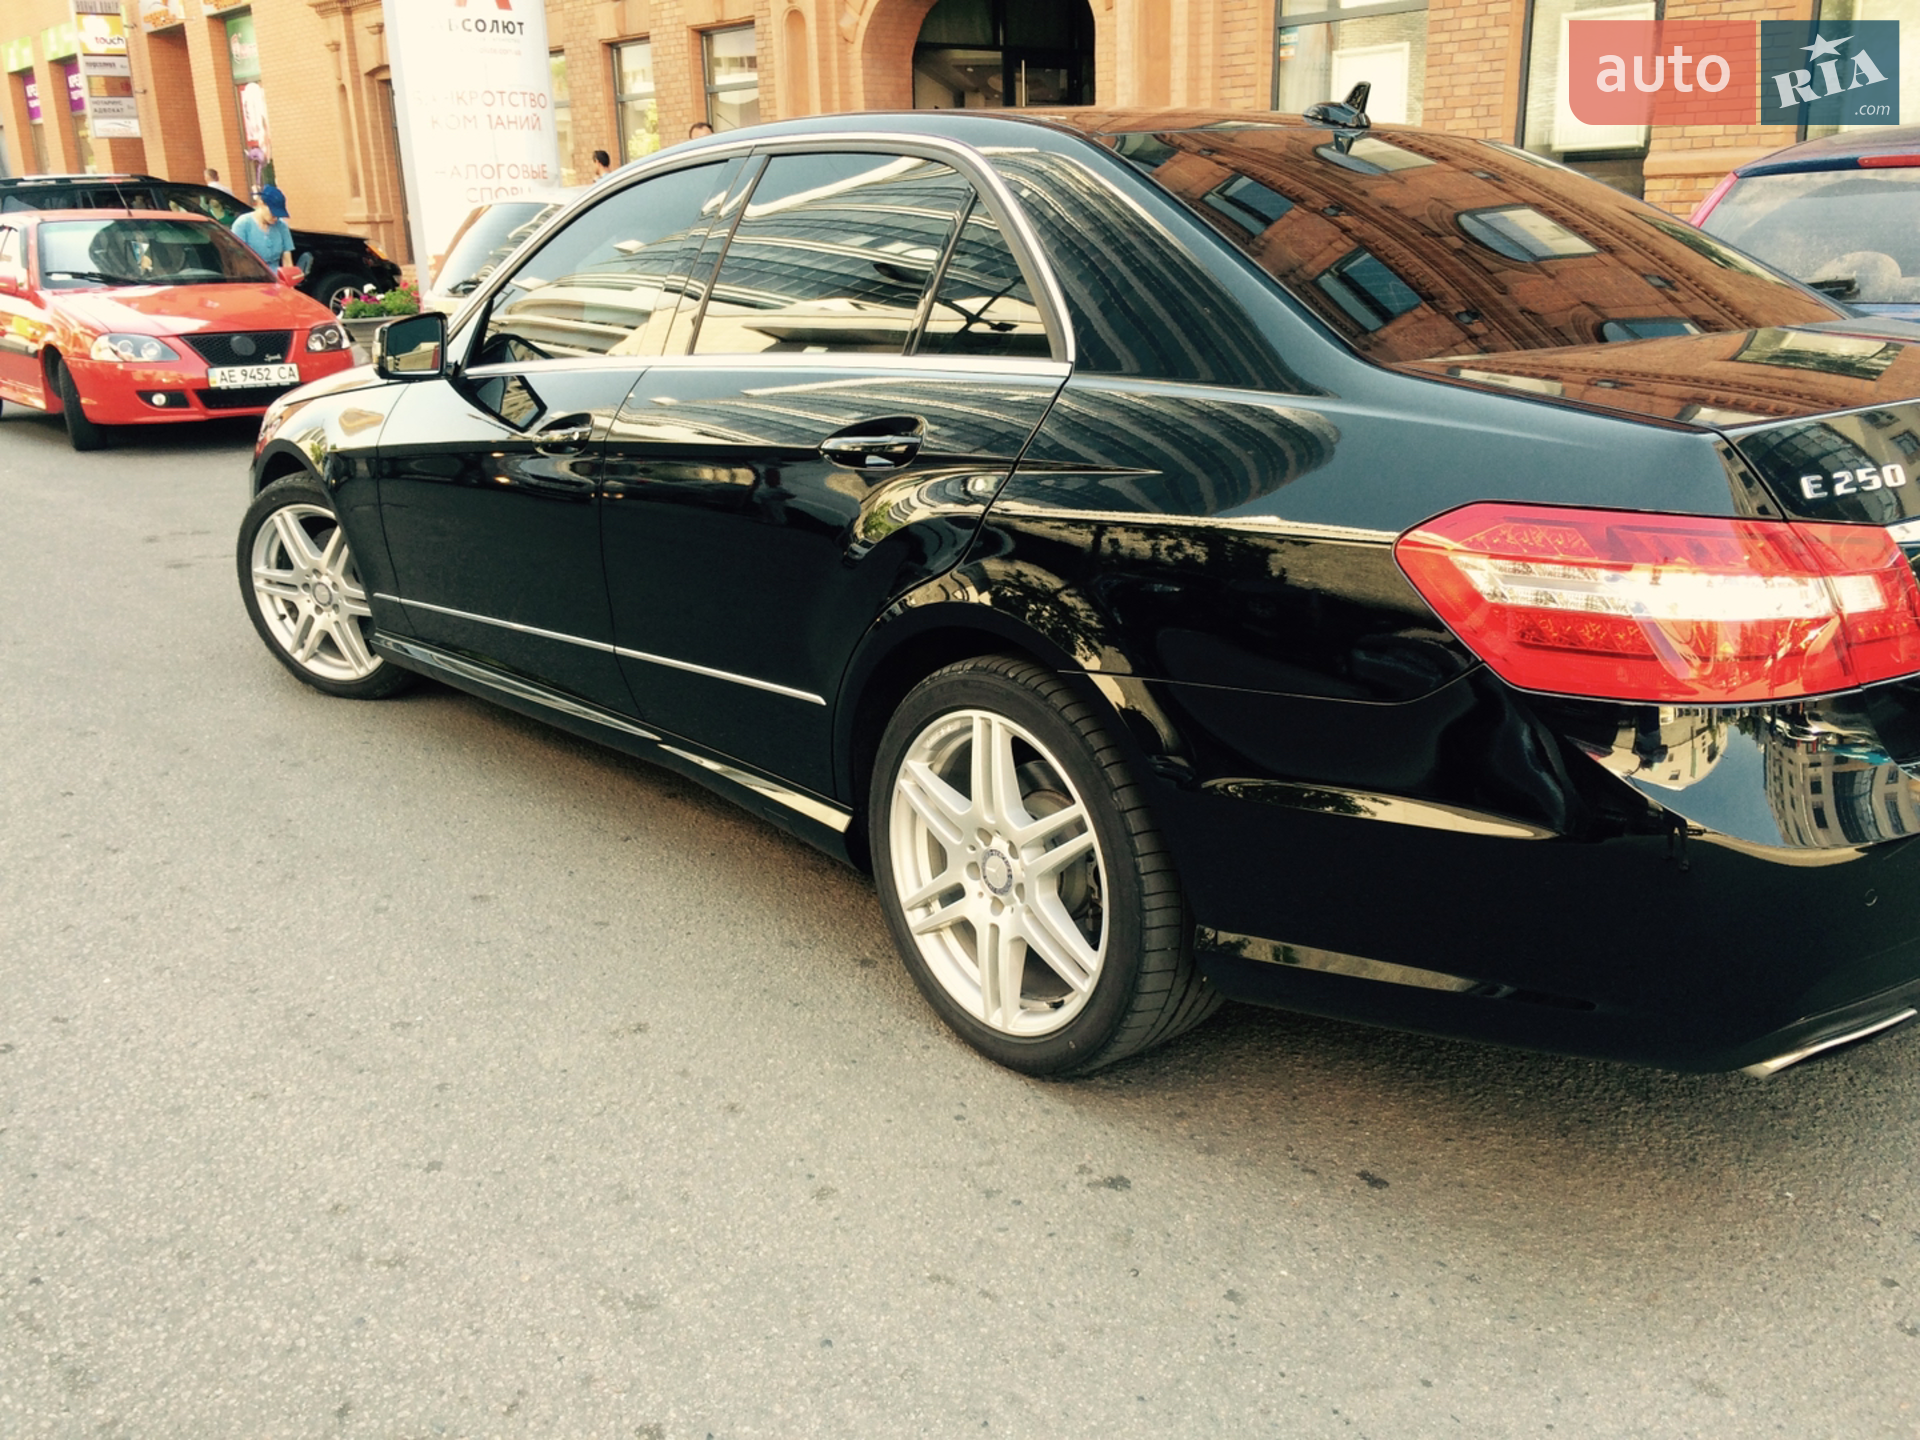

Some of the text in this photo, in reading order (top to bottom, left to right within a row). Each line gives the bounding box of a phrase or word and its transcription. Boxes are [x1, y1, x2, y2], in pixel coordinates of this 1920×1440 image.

[94, 36, 125, 45] touch
[220, 366, 296, 383] AE 9452 CA
[1801, 464, 1906, 500] E 250
